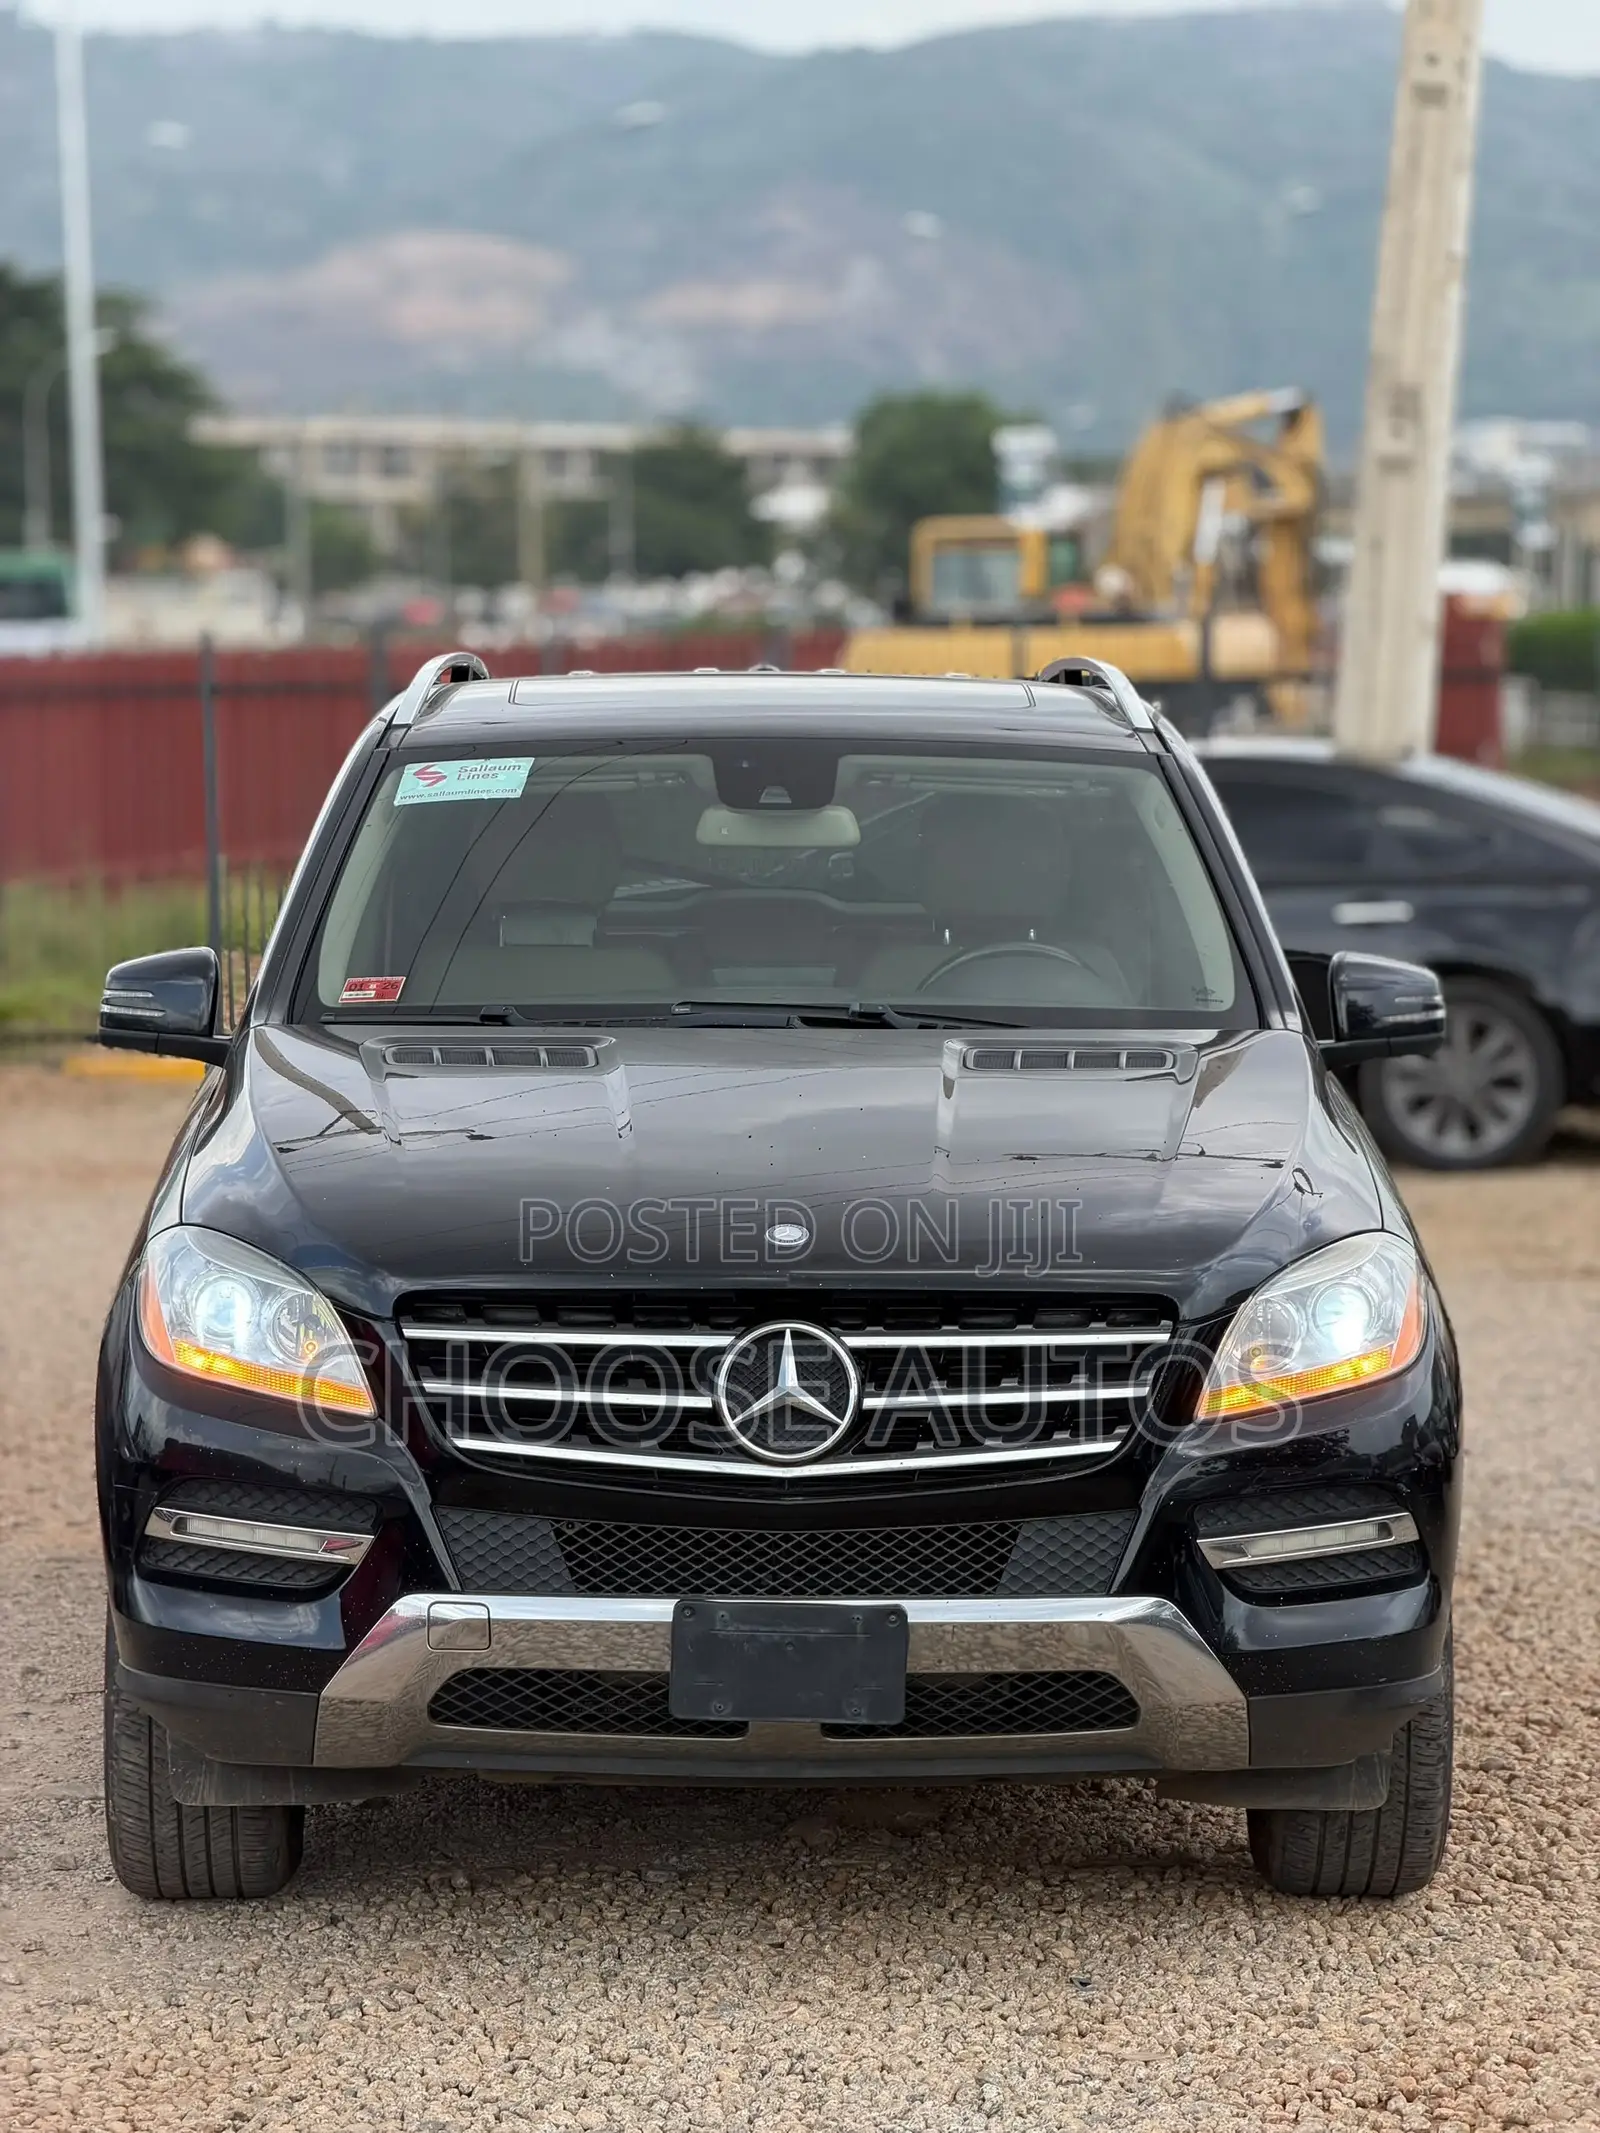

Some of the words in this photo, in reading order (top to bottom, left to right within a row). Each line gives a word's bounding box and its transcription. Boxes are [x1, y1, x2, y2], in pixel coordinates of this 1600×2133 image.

[457, 763, 522, 774] Sallaum
[457, 772, 499, 781] Lines
[399, 787, 517, 800] www.sallaumlines.com
[381, 982, 398, 990] 26
